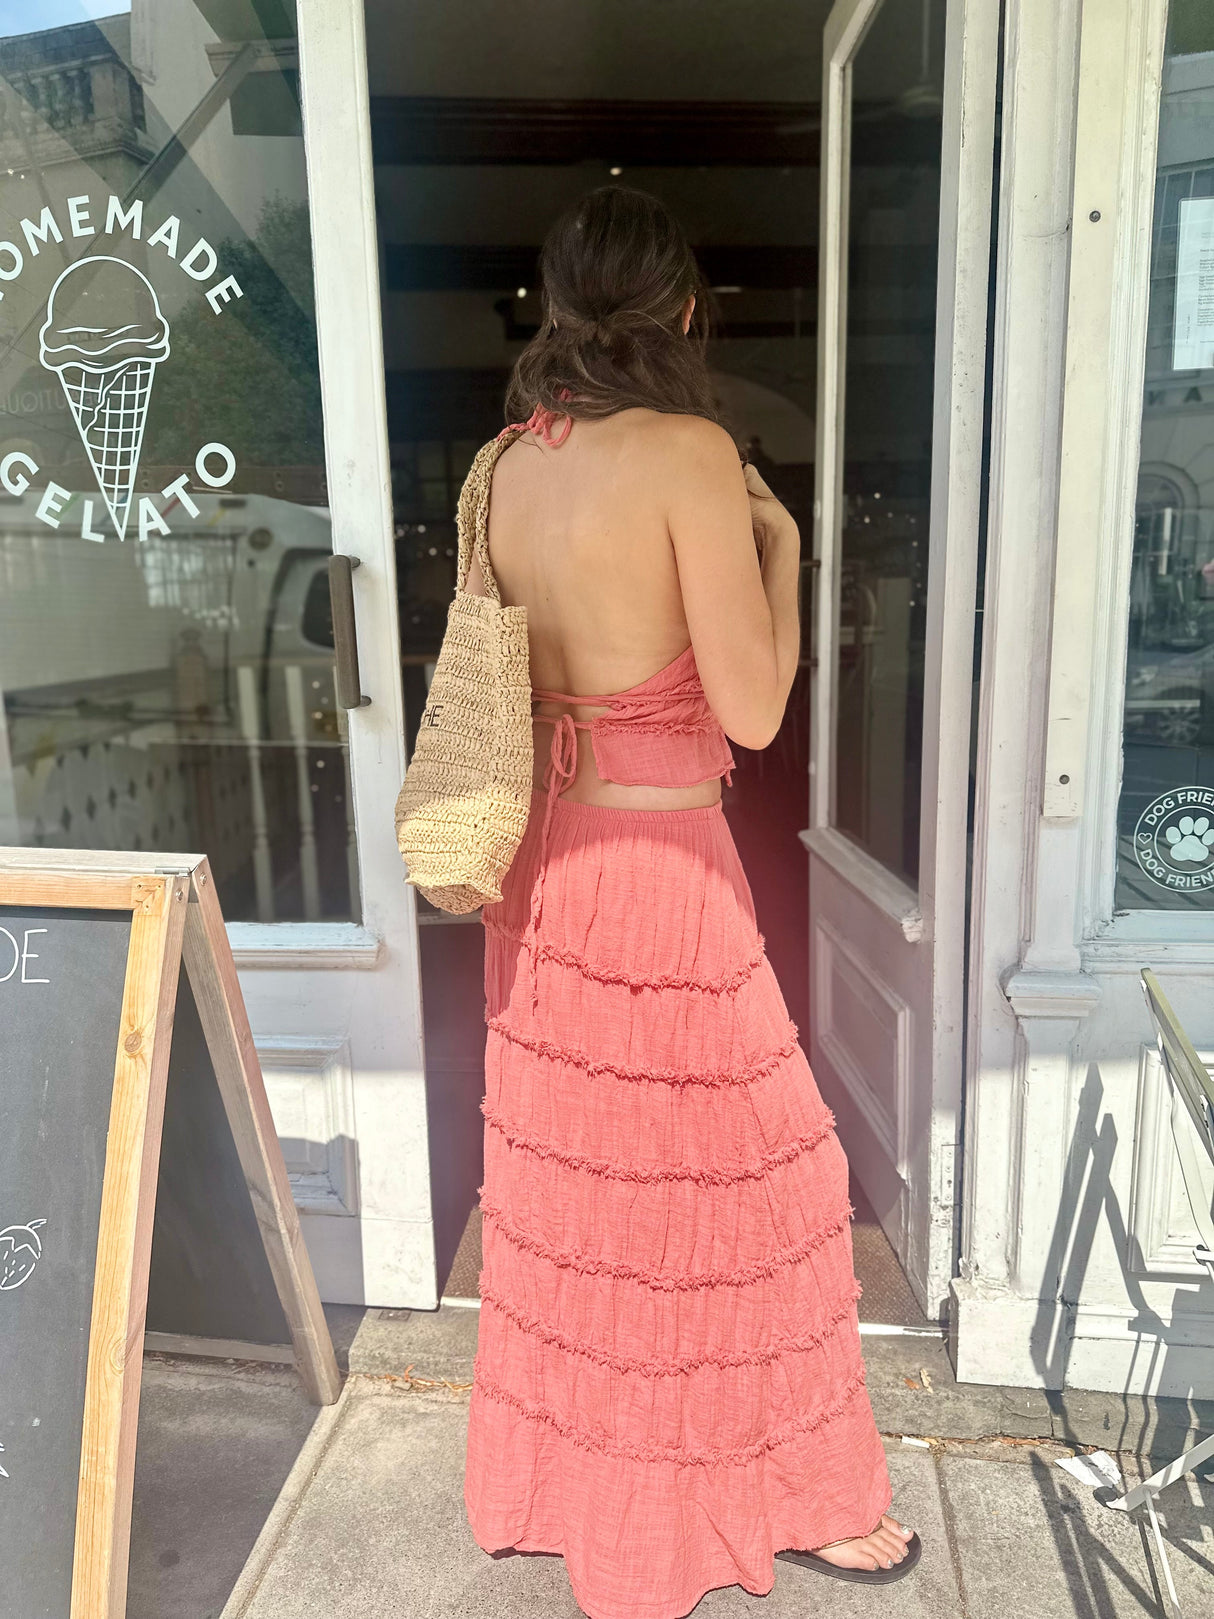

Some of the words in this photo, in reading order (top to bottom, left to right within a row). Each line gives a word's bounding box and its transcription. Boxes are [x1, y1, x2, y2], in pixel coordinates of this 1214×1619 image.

[0, 195, 244, 315] OMEMADE
[0, 442, 236, 543] GELATO
[1144, 797, 1175, 826] DOG
[1177, 791, 1214, 806] FRIE
[1140, 848, 1166, 878] DOG
[1165, 870, 1214, 887] FRIEN
